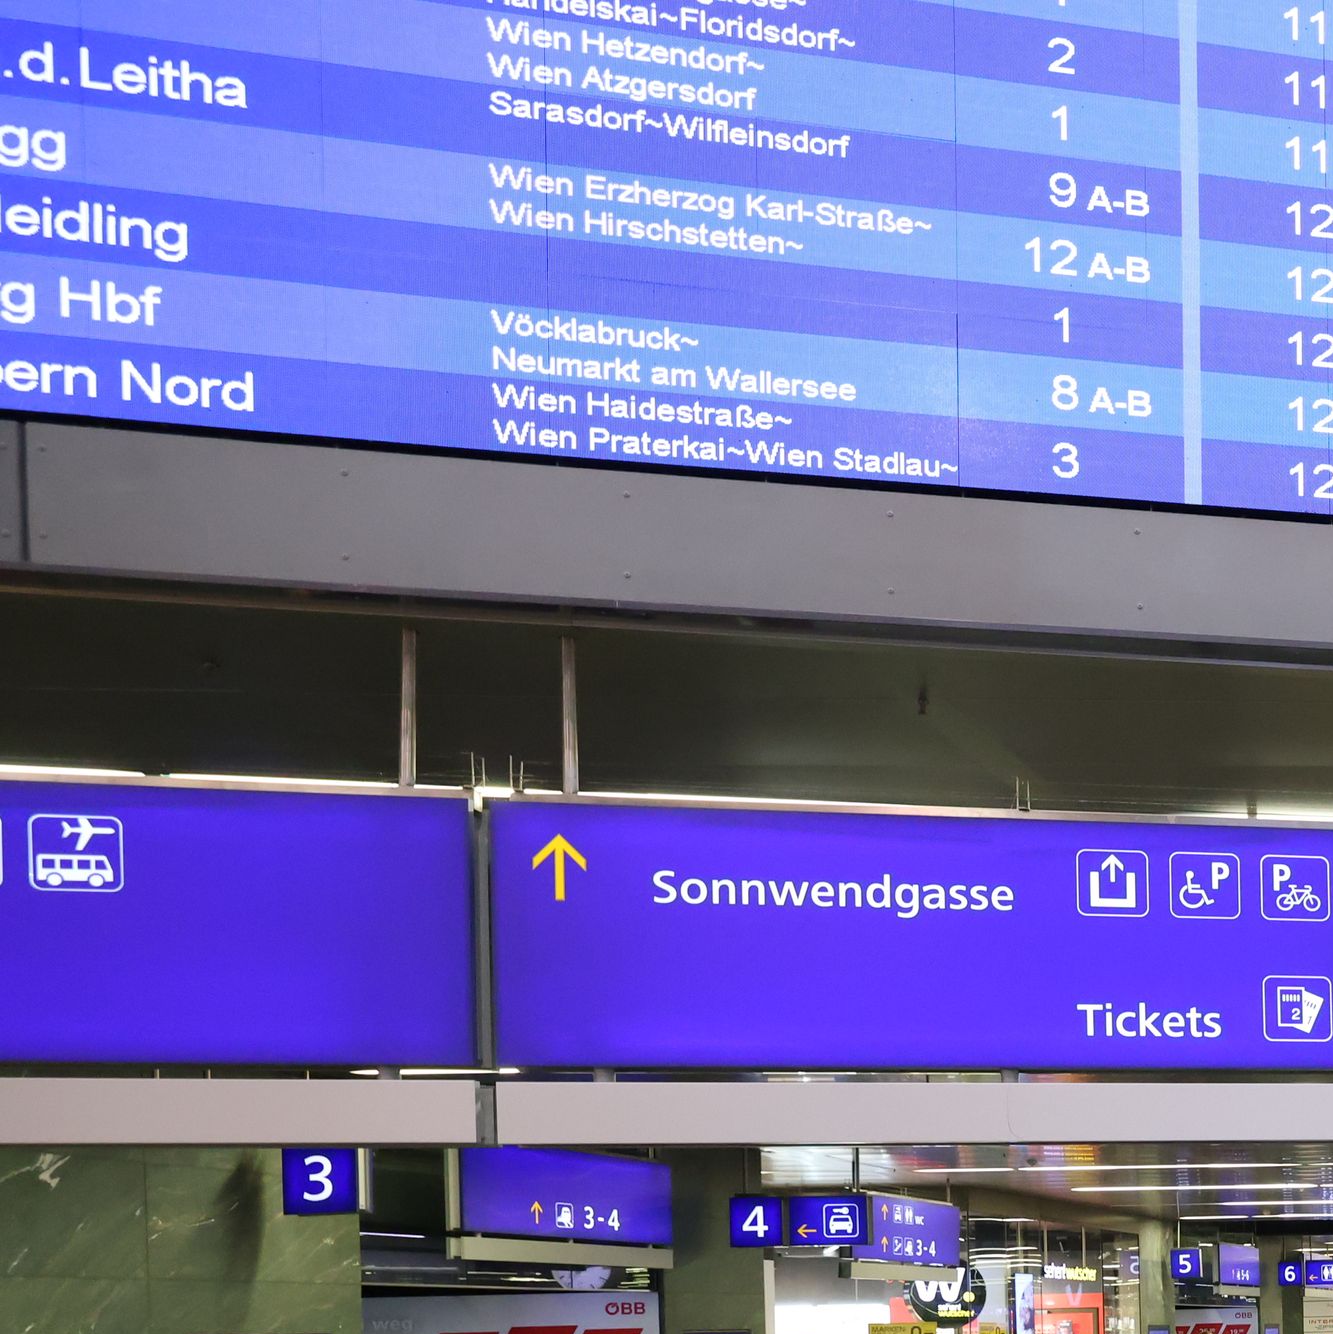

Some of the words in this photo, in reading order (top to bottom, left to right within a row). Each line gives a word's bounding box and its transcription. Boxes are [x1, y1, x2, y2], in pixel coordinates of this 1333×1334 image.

[489, 164, 573, 196] Wien
[585, 175, 739, 236] Erzherzog
[1050, 173, 1076, 208] 9
[1087, 190, 1149, 216] A-B
[0, 197, 187, 262] eidling
[1025, 237, 1077, 276] 12
[1088, 253, 1150, 283] A-B
[60, 277, 162, 325] Hbf
[122, 360, 253, 411] Nord
[493, 346, 640, 382] Neumarkt
[652, 367, 696, 387] am
[706, 366, 856, 401] Wallersee
[1053, 443, 1079, 478] 3
[652, 870, 1015, 920] Sonnwendgasse
[1076, 1002, 1223, 1039] Tickets
[302, 1154, 334, 1203] 3
[741, 1206, 769, 1239] 4
[1178, 1254, 1192, 1274] 5
[1284, 1266, 1296, 1282] 6
[605, 1302, 646, 1315] ÖBB
